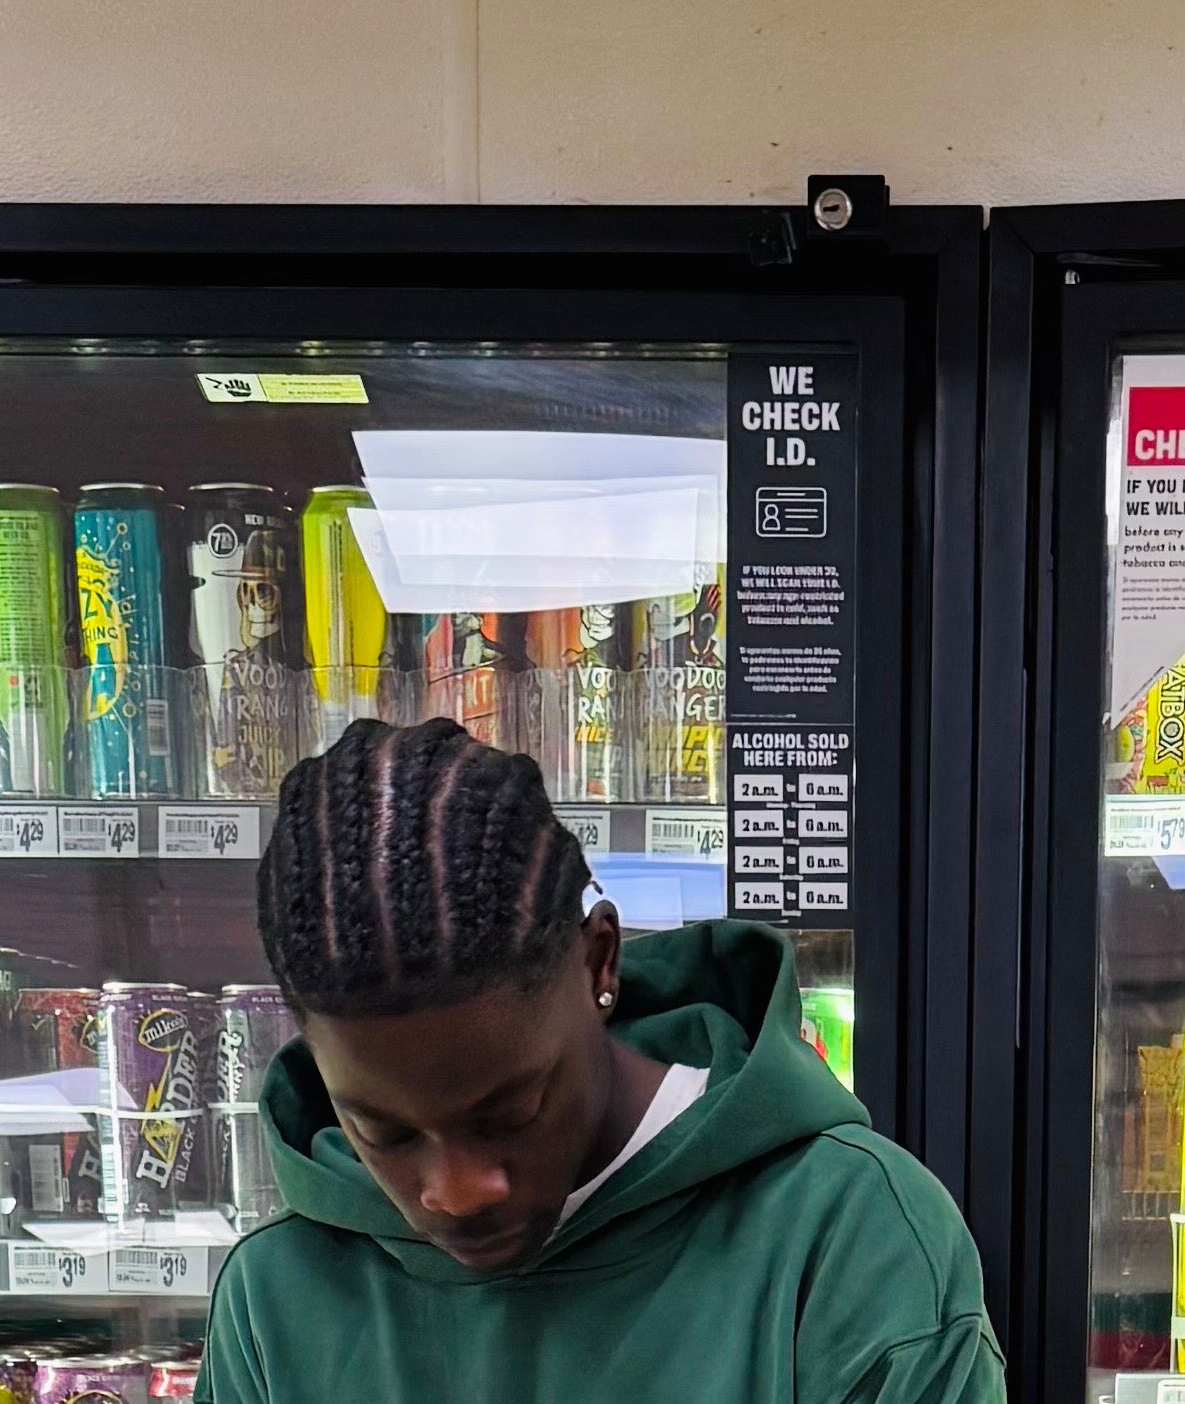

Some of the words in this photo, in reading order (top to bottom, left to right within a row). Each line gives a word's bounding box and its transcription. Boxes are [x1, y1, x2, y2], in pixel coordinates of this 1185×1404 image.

[769, 366, 814, 394] WE
[742, 402, 840, 431] CHECK
[766, 437, 815, 466] I.D.
[1127, 480, 1141, 493] IF
[1147, 480, 1177, 493] YOU
[1127, 502, 1150, 515] WE
[732, 733, 804, 749] ALCOHOL
[808, 733, 849, 749] SOLD
[744, 751, 784, 766] HERE
[787, 751, 838, 766] FROM:
[742, 783, 750, 796] 2
[742, 819, 750, 832] 2
[742, 855, 750, 868] 2
[742, 891, 750, 904] 2
